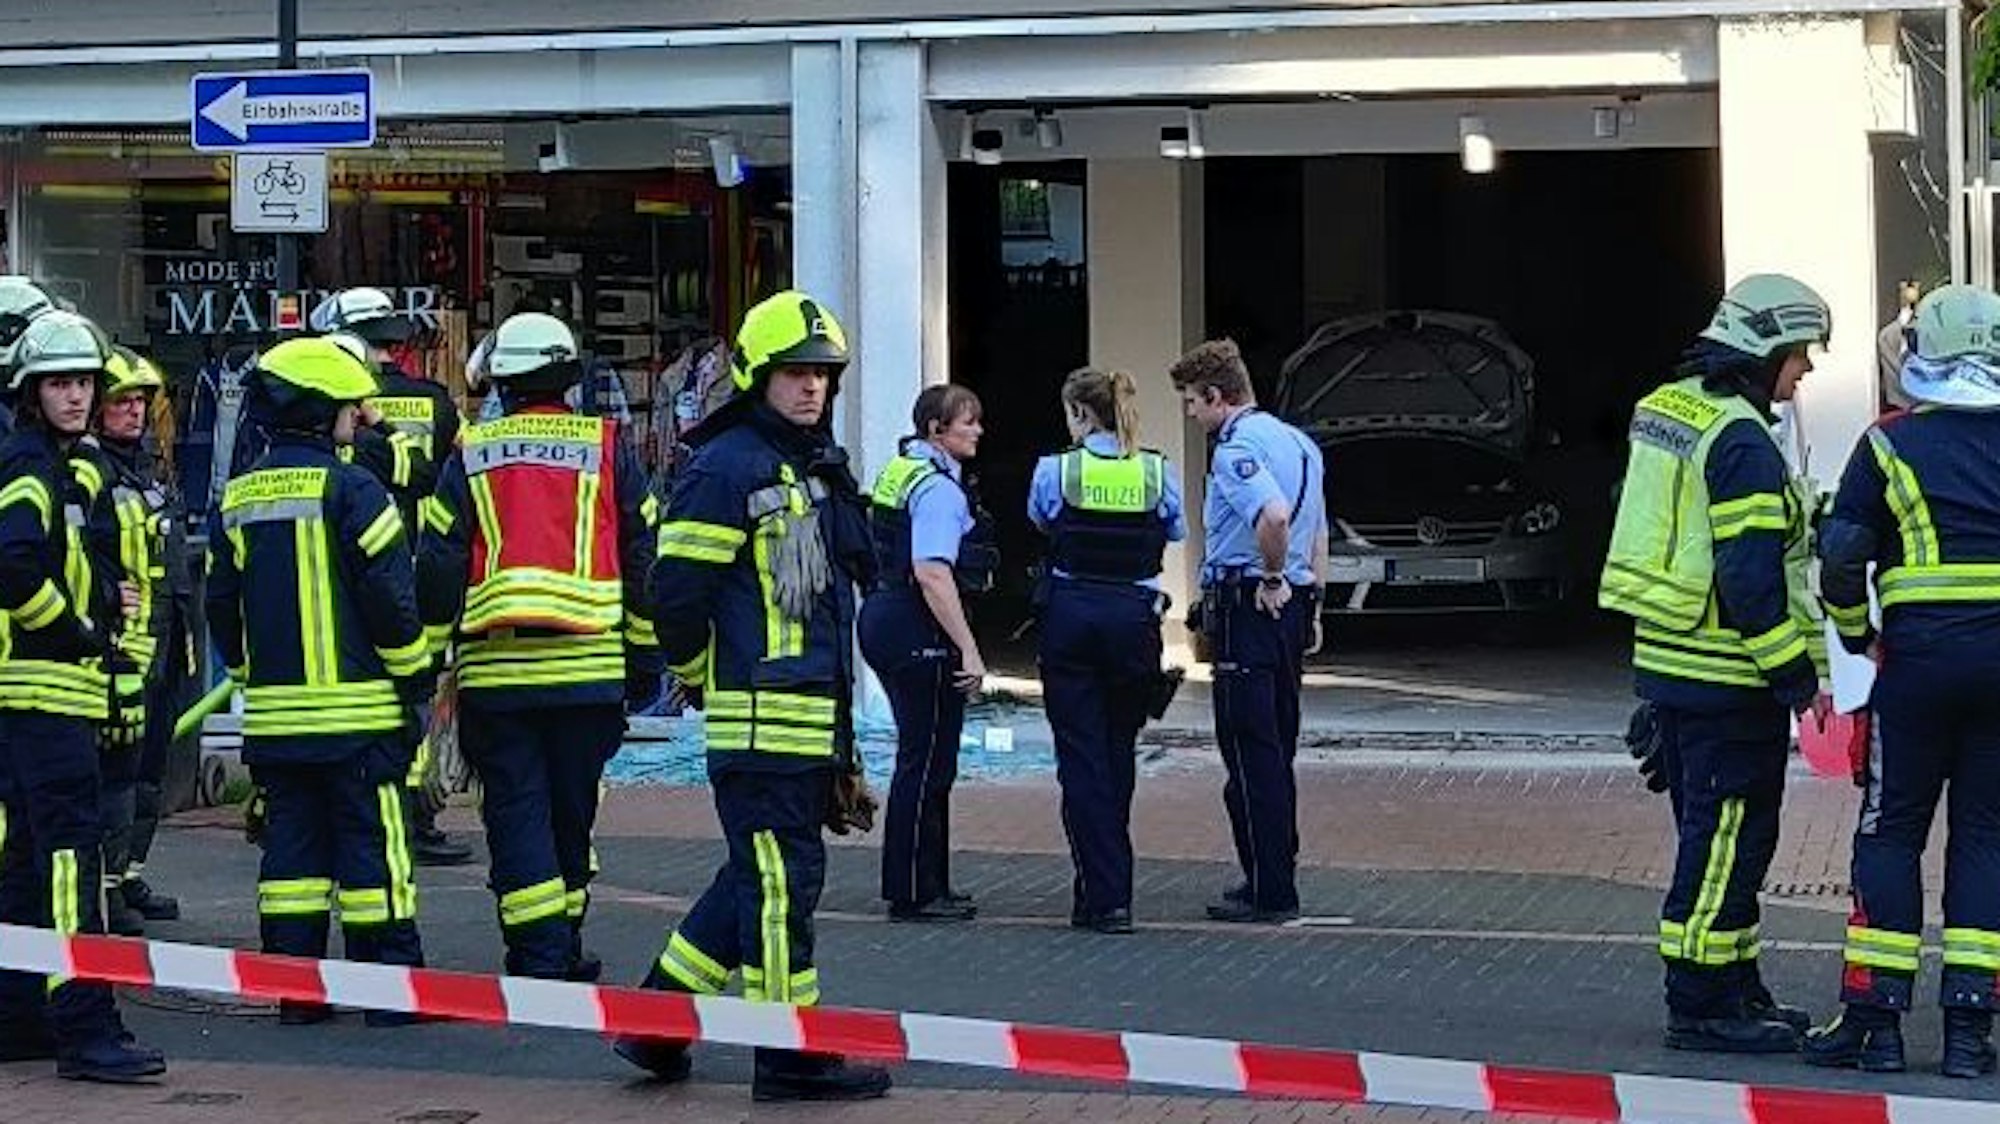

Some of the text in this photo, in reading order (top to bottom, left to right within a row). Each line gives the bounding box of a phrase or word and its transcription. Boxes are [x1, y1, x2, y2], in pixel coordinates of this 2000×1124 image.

[243, 101, 361, 118] Einbahnstraße
[166, 257, 278, 281] MODE FÜ
[478, 444, 588, 465] 1 LF20-1
[1085, 485, 1142, 506] POLIZEI
